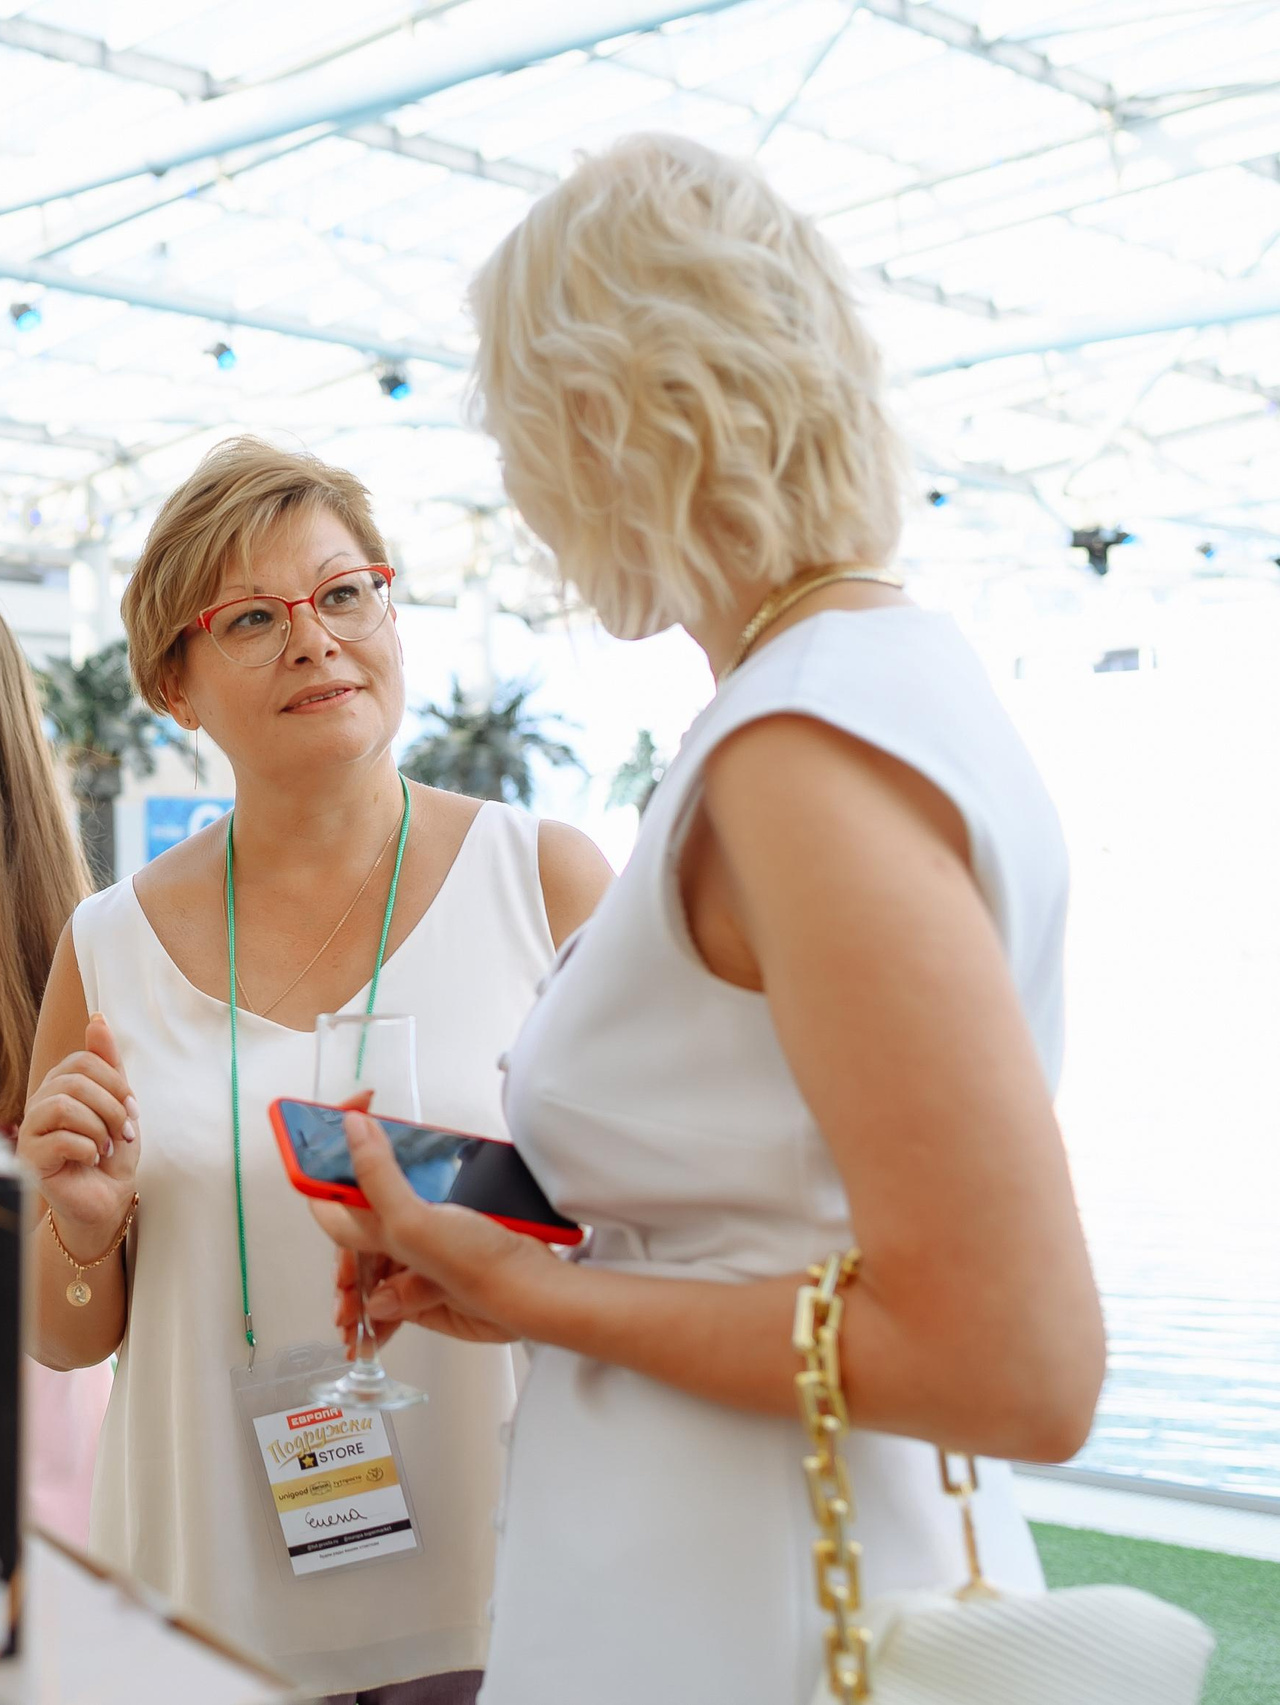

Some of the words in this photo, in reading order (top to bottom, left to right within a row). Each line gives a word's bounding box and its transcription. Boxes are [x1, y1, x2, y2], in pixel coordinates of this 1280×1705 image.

[267, 1418, 373, 1464] Подружки
[318, 1442, 365, 1463] STORE
[278, 1488, 309, 1501] unigood
